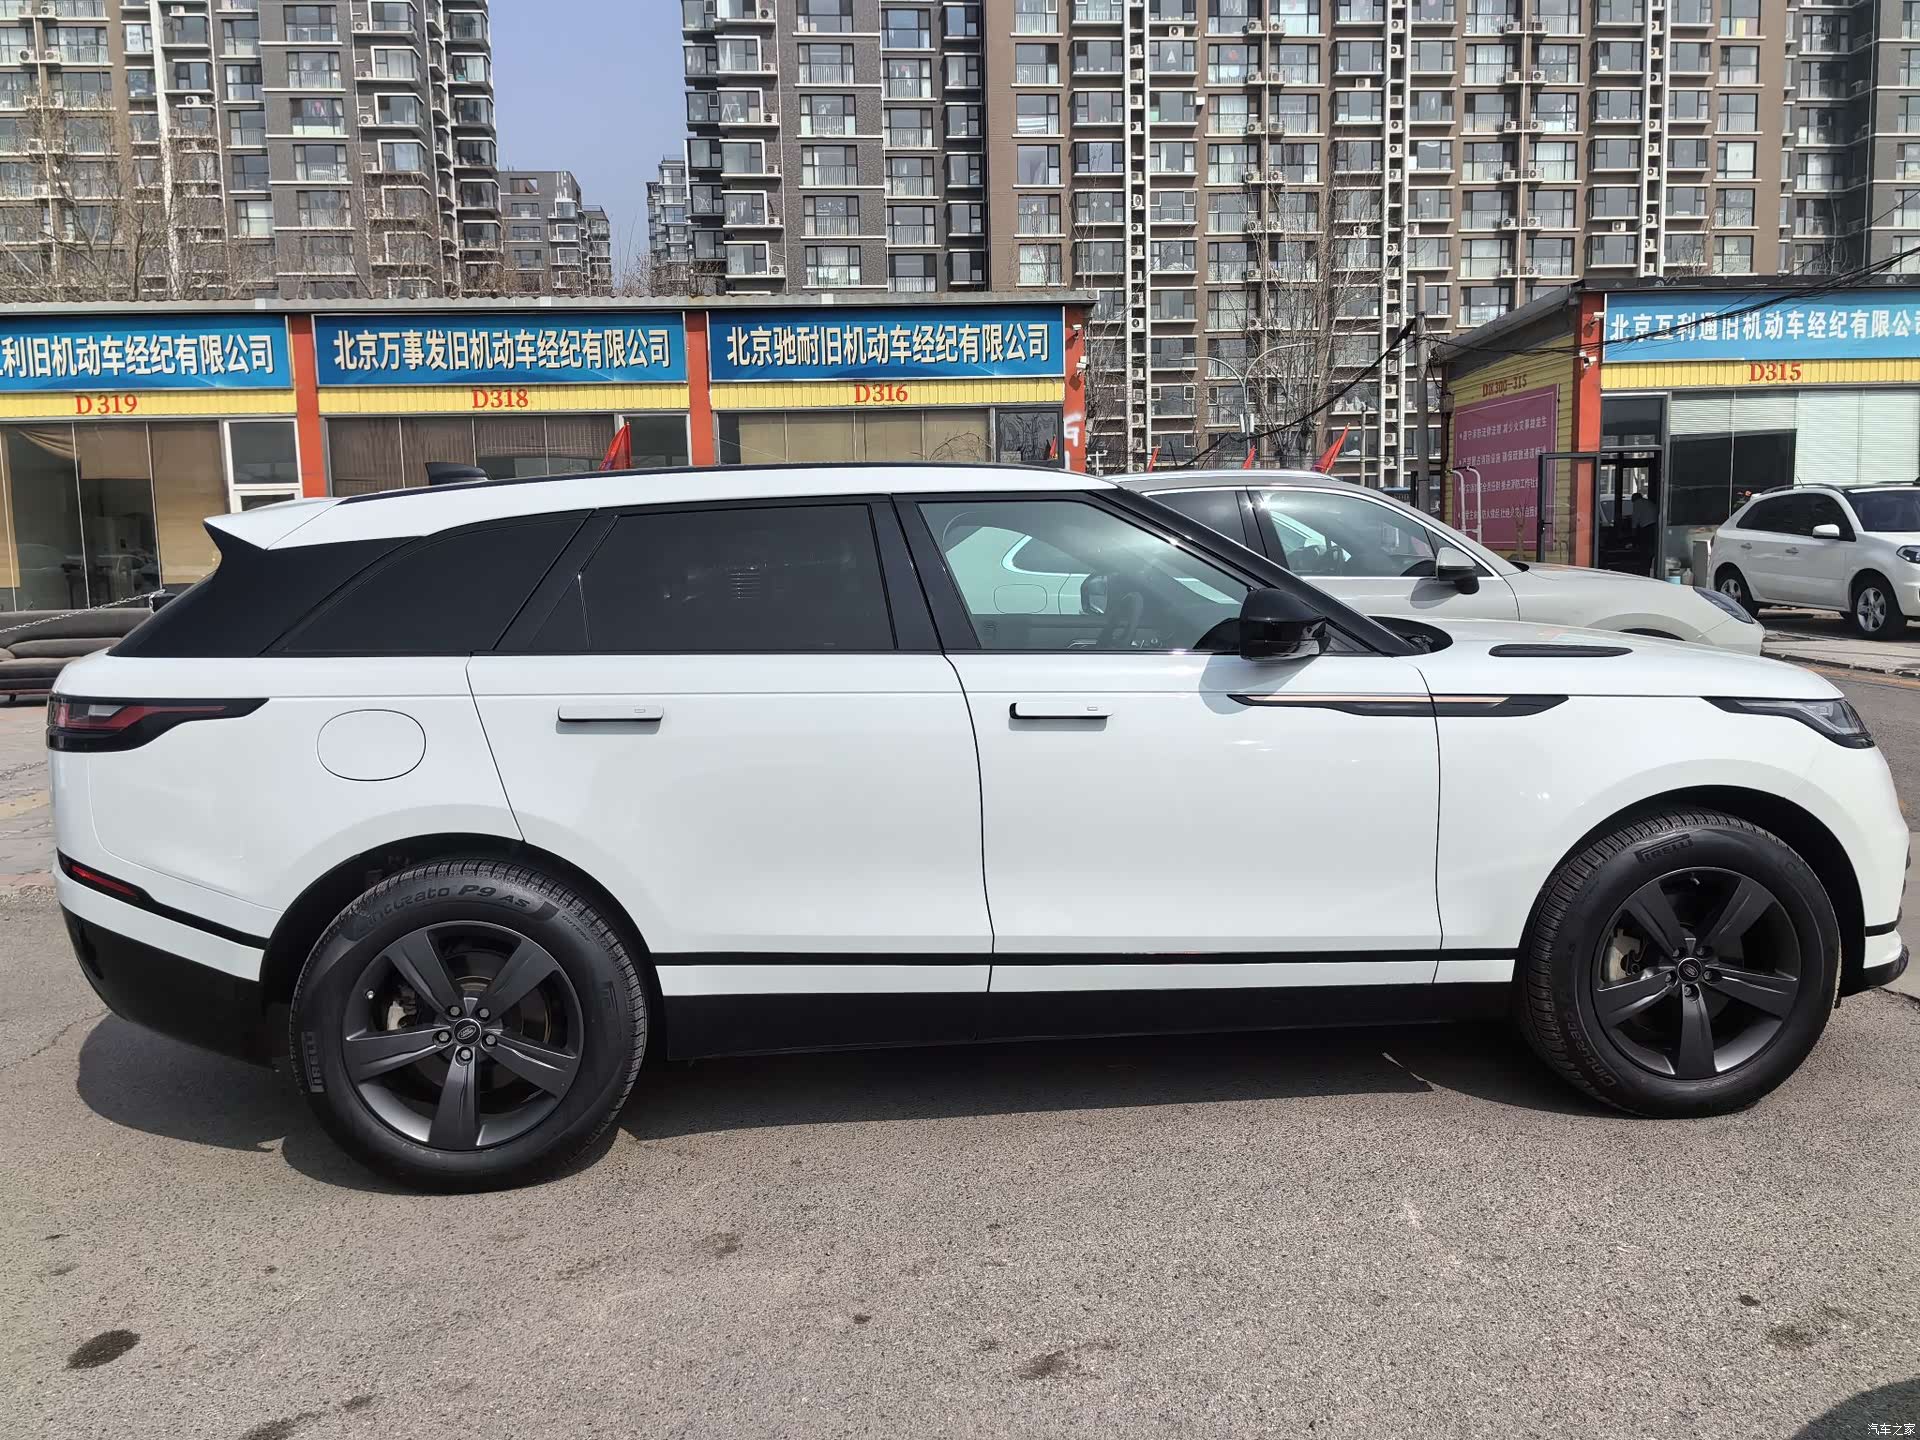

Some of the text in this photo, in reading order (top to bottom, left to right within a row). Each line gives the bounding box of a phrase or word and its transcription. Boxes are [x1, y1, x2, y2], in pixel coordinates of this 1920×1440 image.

[334, 328, 671, 372] 北京万事发旧机动车经纪有限公司
[727, 323, 1049, 367] 北京驰耐旧机动车经纪有限公司
[0, 334, 274, 378] 利旧机动车经纪有限公司
[1749, 362, 1802, 382] D315
[471, 389, 529, 408] D318
[854, 384, 908, 404] D316
[75, 394, 138, 415] D319
[457, 884, 497, 897] P9
